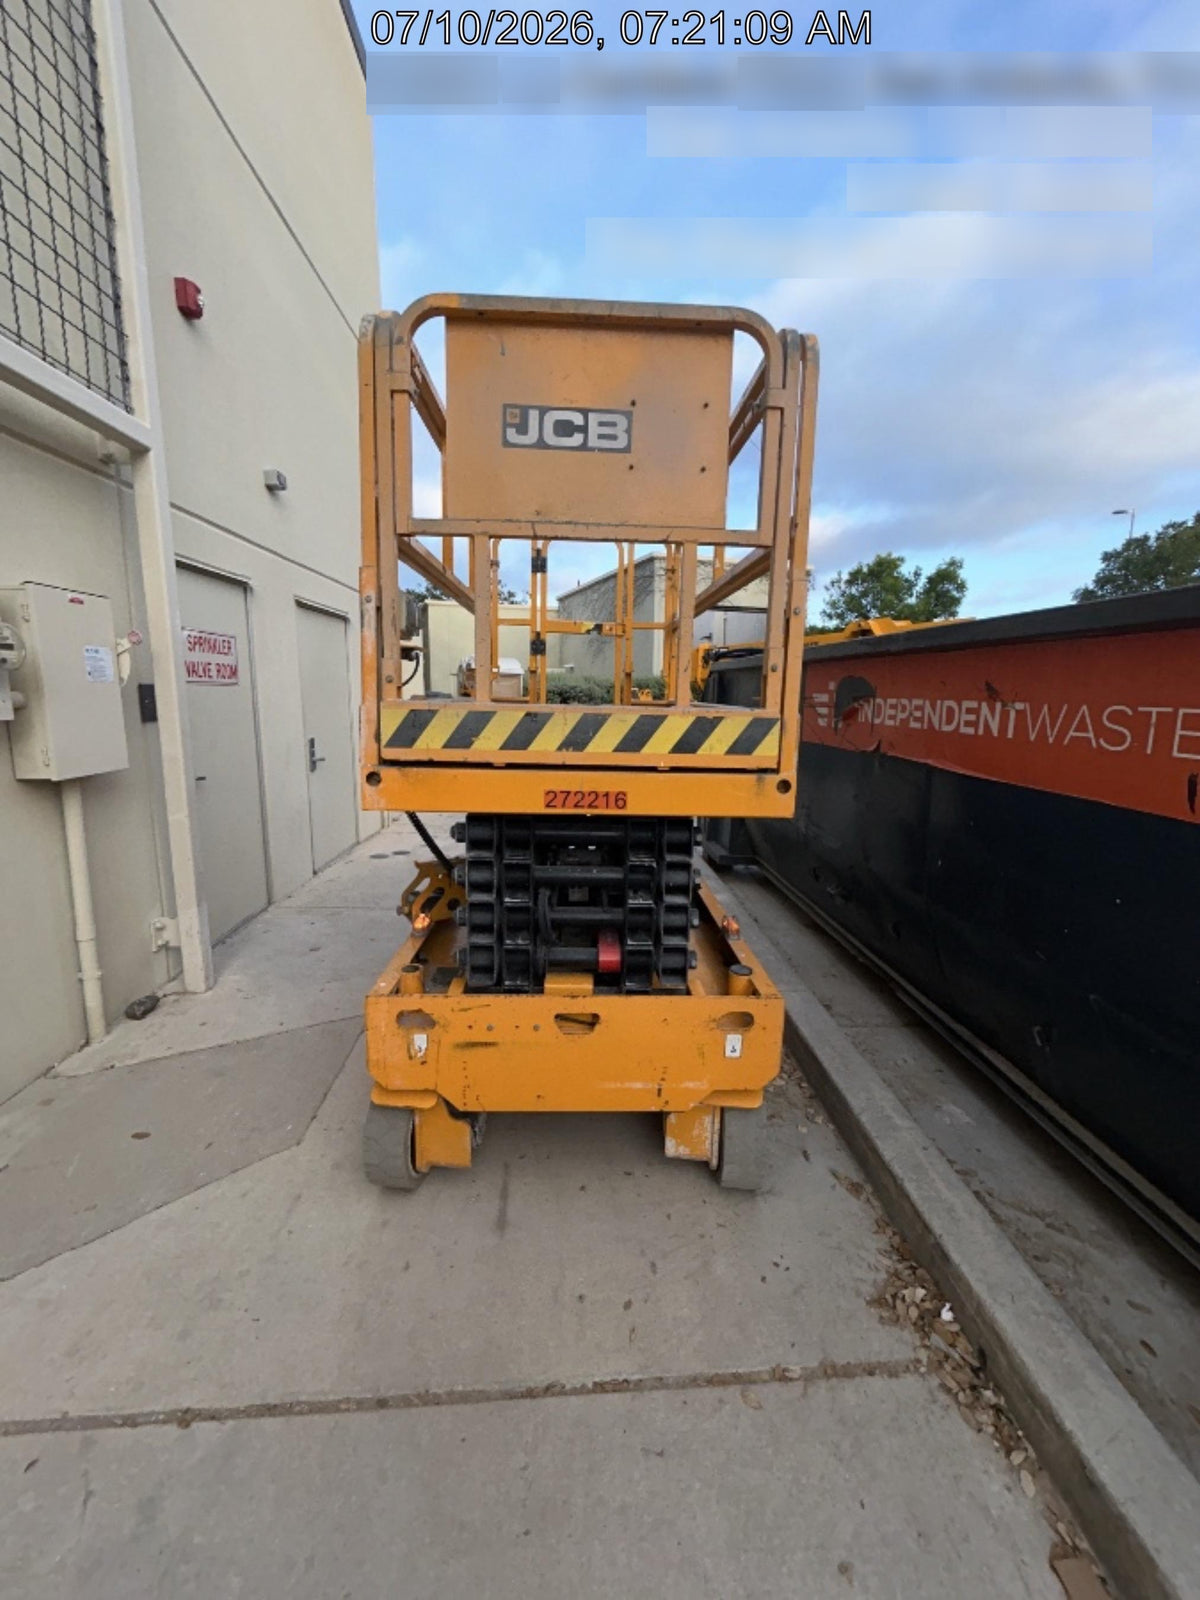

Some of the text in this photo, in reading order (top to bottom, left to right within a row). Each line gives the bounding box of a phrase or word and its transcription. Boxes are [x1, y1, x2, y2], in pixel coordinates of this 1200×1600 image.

[506, 408, 629, 449] JCB
[185, 660, 238, 680] VALVE ROOM
[544, 790, 627, 810] 272216
